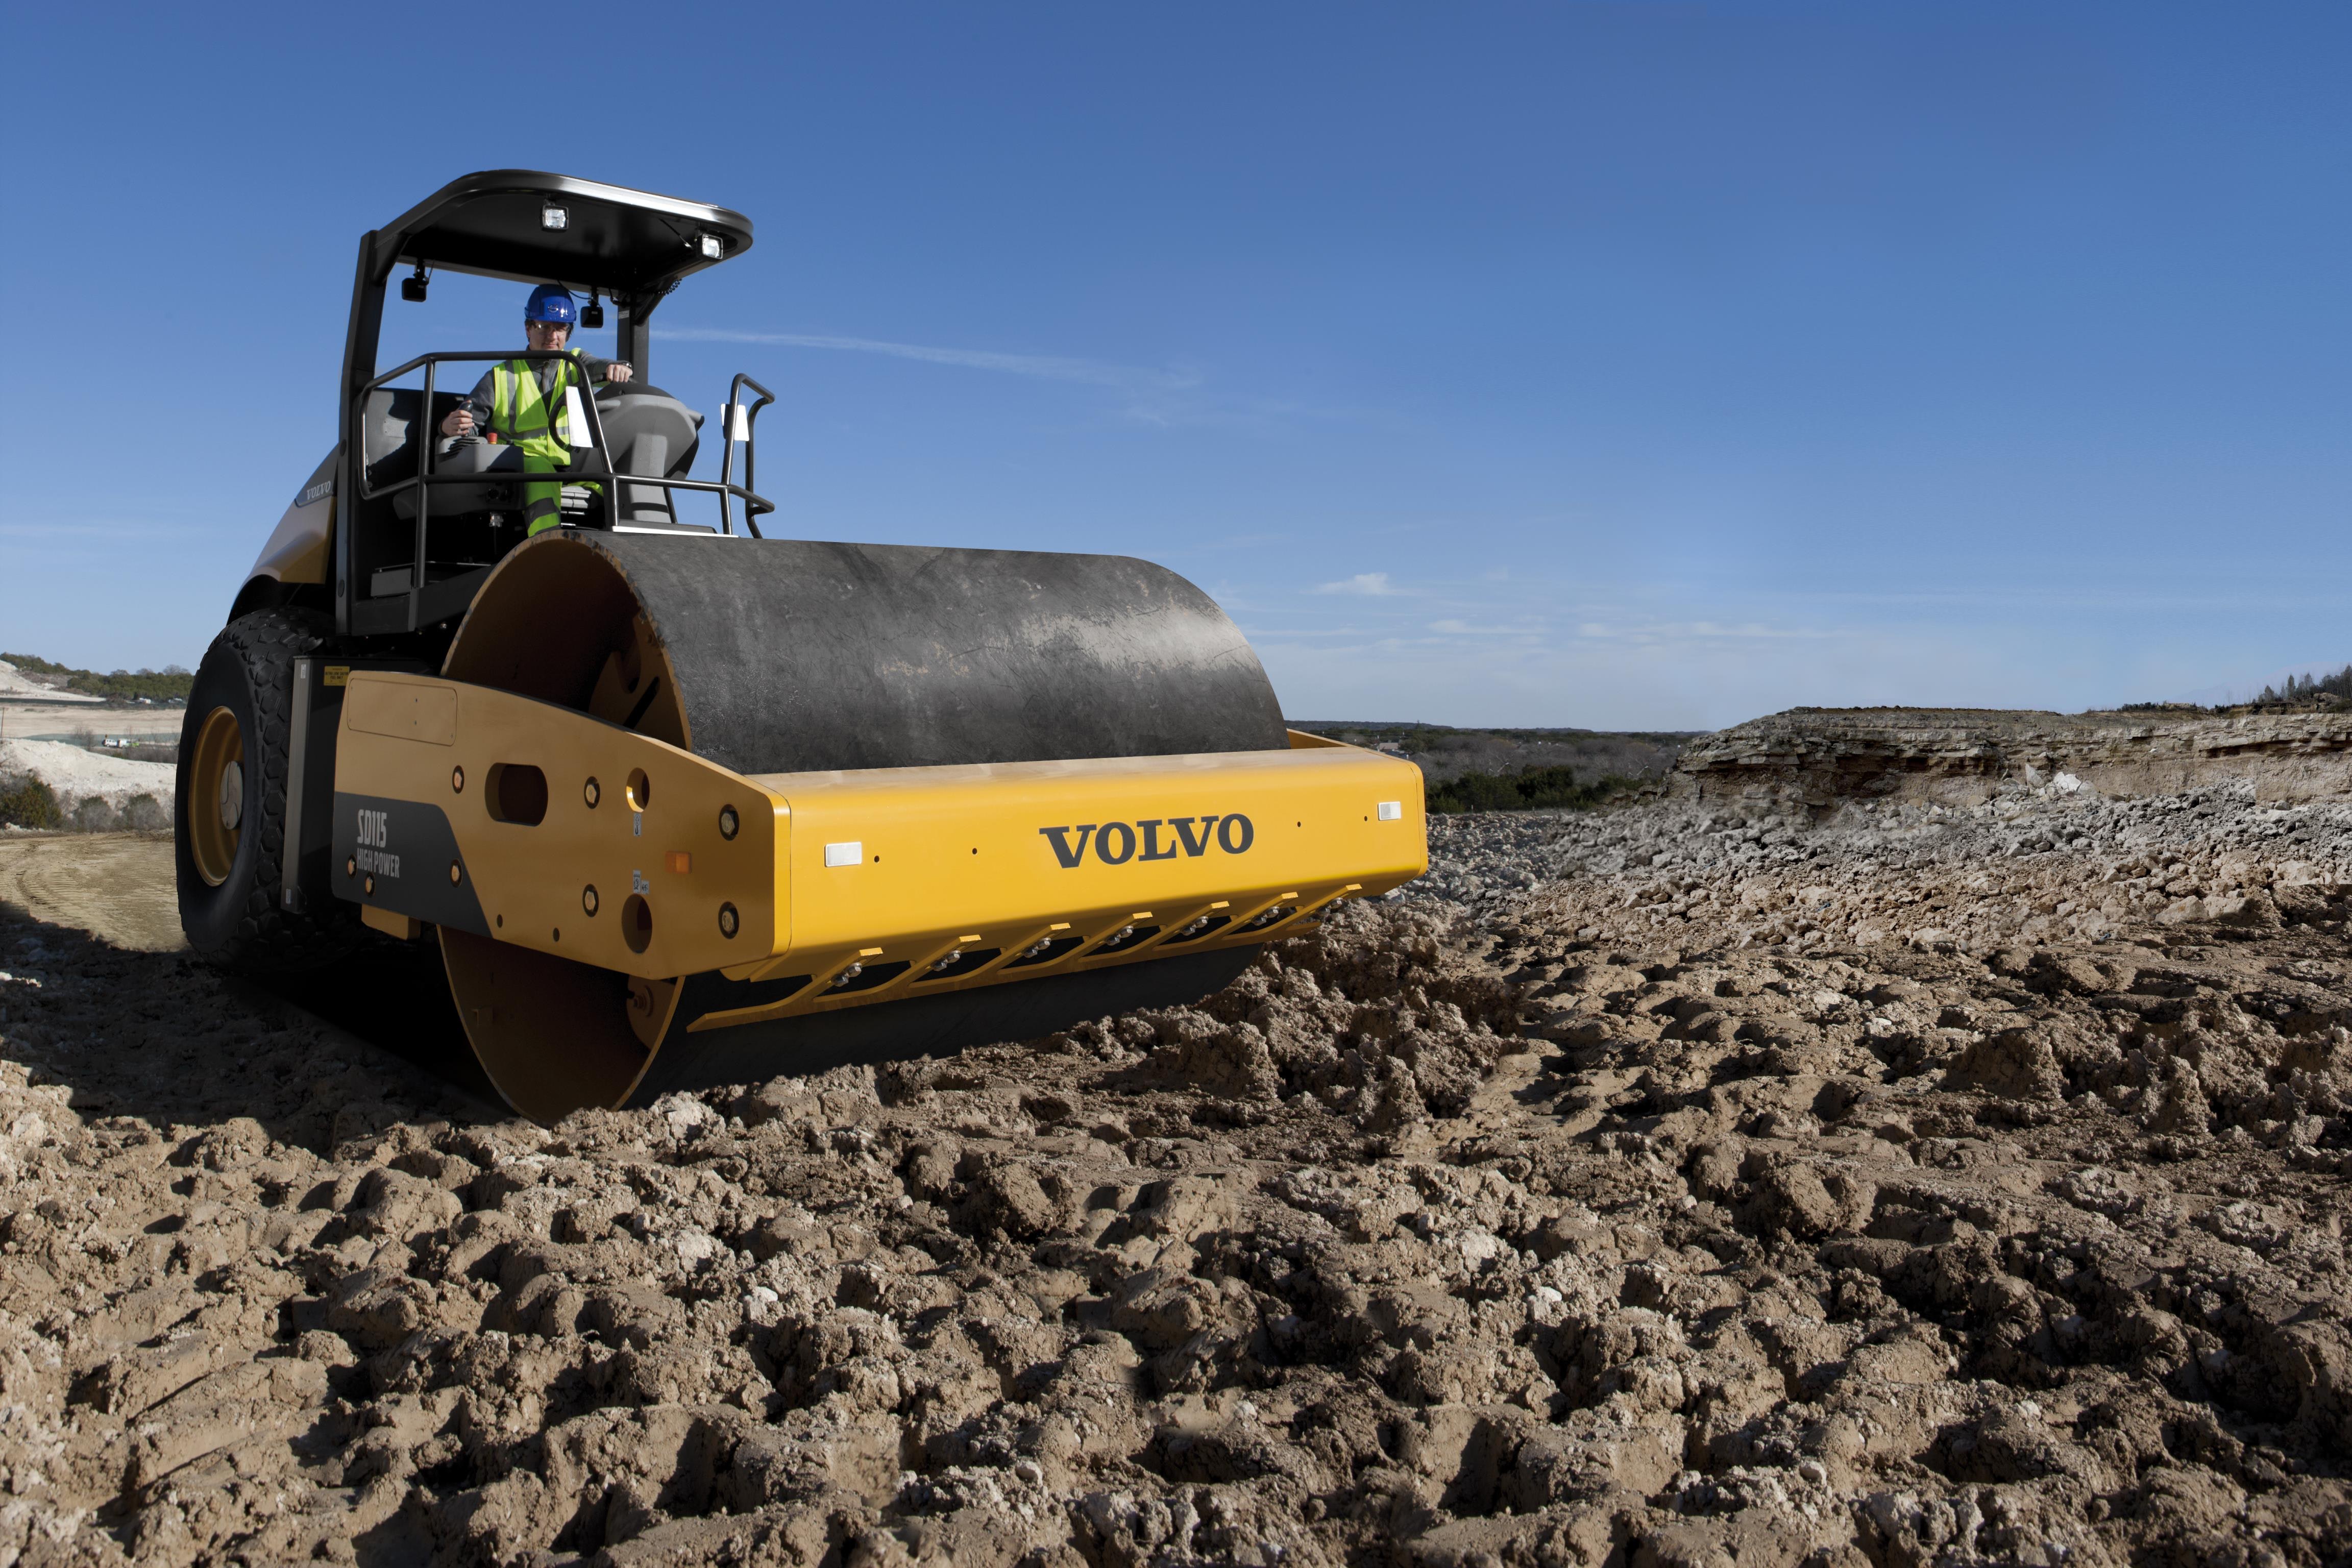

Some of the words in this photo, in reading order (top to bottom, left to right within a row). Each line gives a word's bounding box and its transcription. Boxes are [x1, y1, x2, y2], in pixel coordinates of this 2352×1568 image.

[307, 480, 331, 500] VOLVO
[357, 809, 387, 847] SD115
[1039, 813, 1254, 869] VOLVO
[357, 848, 373, 872] HIGH
[374, 851, 400, 878] POWER
